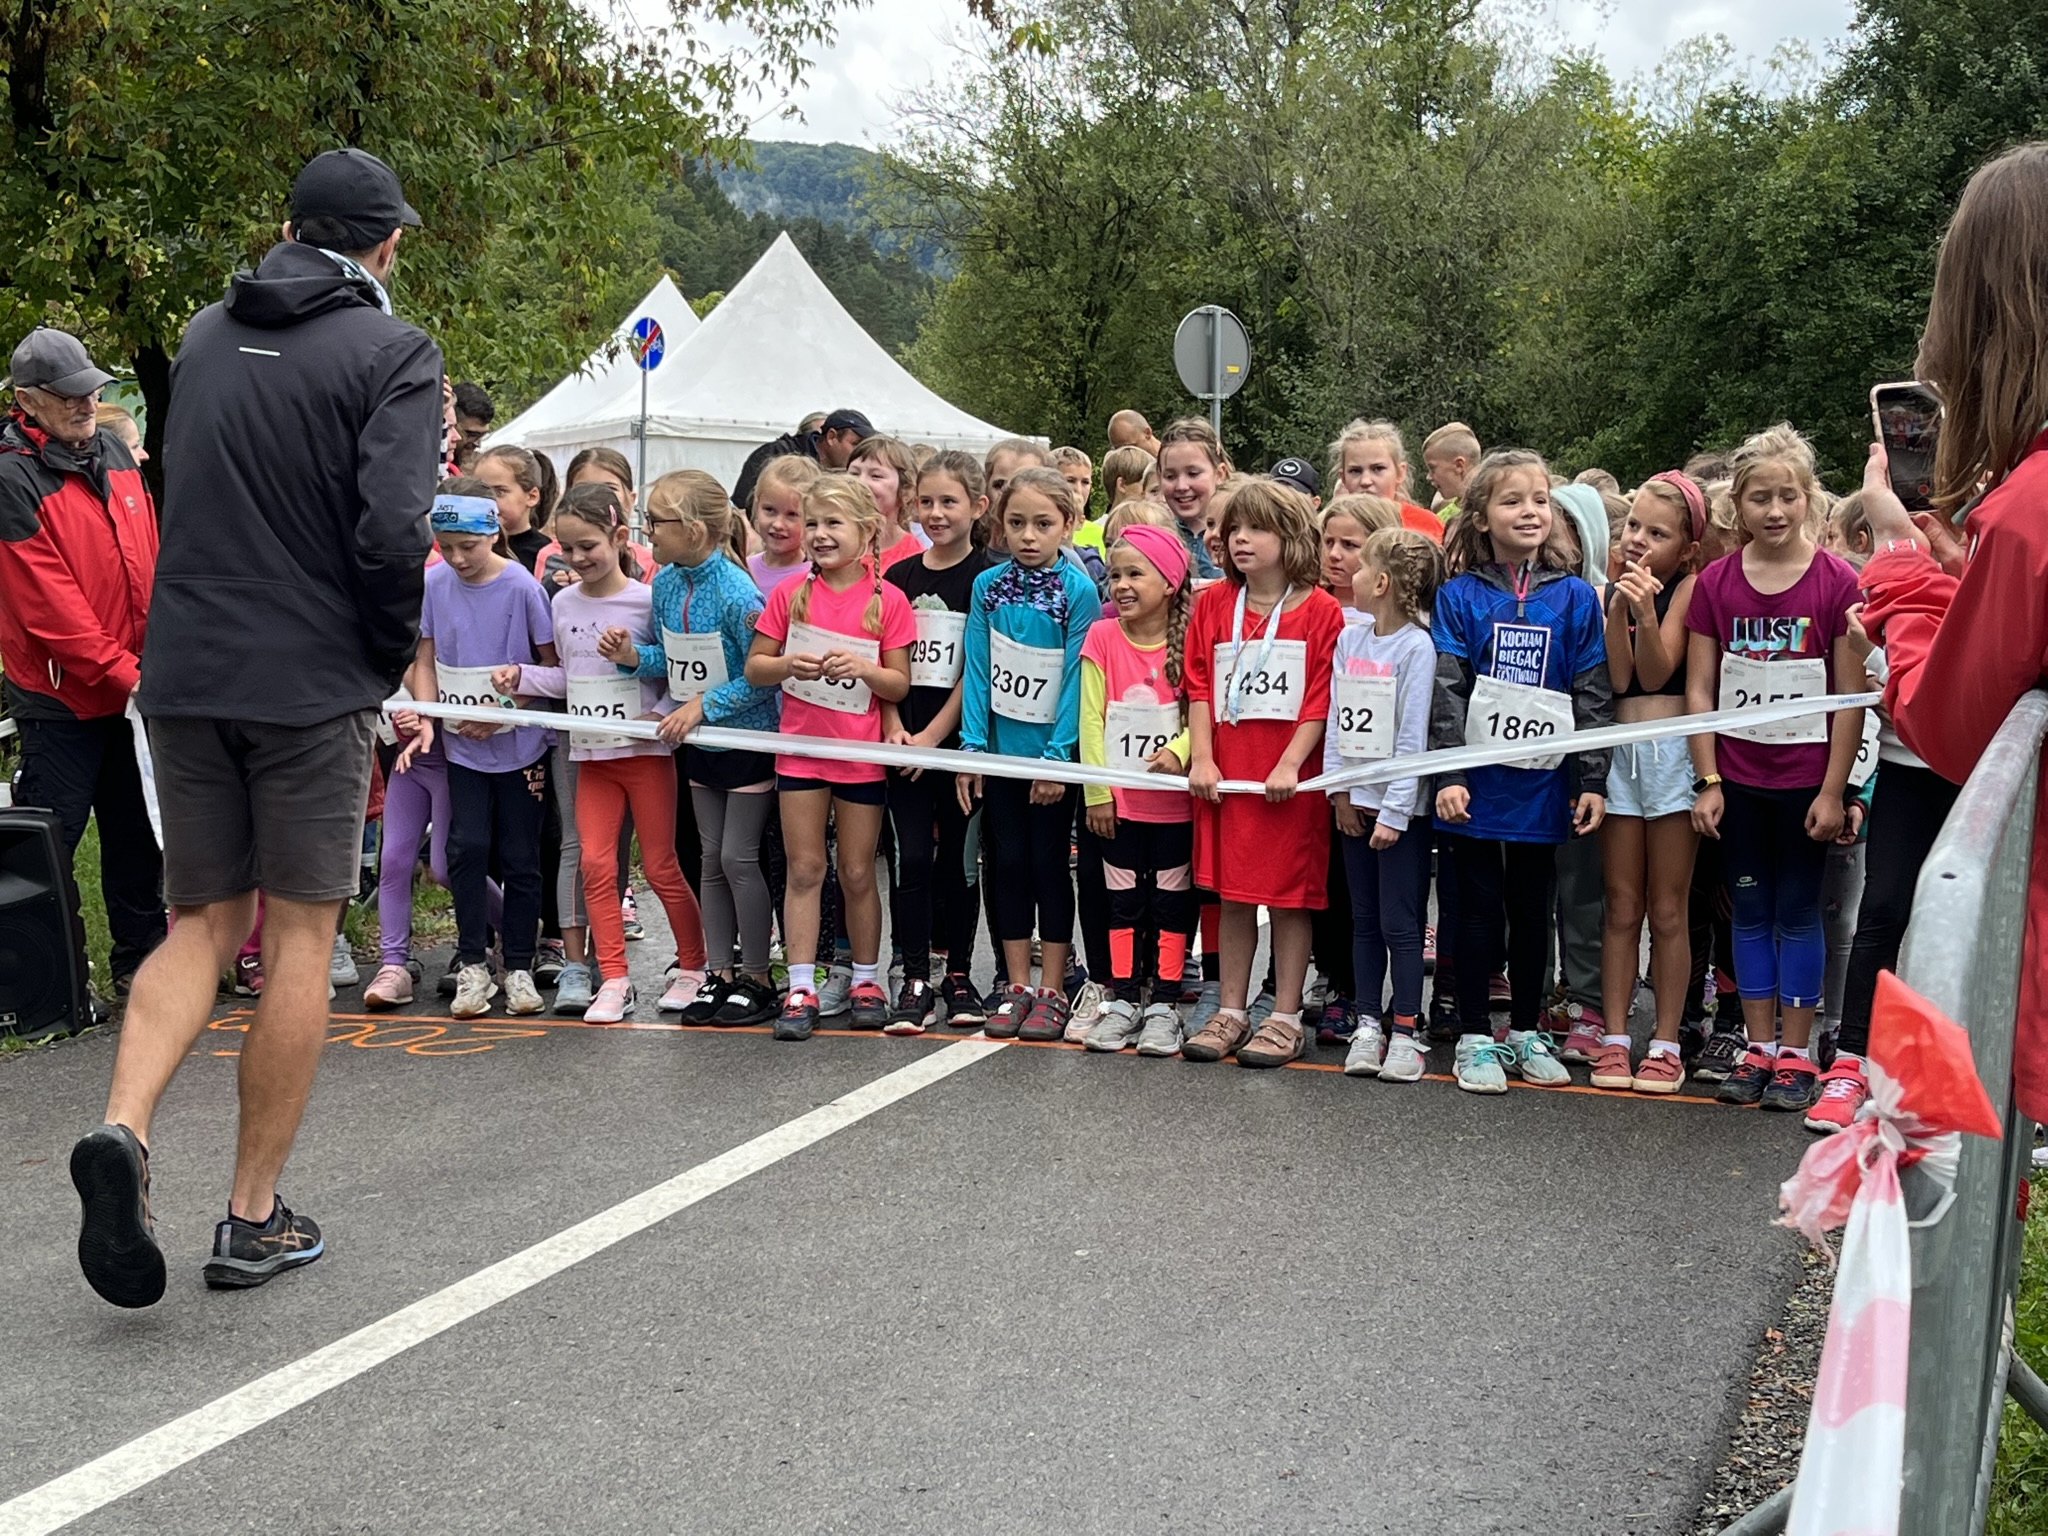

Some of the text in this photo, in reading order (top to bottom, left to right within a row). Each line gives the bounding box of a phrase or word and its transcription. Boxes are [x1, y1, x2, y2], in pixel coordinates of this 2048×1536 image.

[1500, 630, 1543, 648] KOCHAM
[1729, 617, 1811, 652] JUST
[911, 640, 955, 666] 2951
[1499, 648, 1542, 669] BIEGAĆ
[992, 663, 1048, 701] 2307
[1336, 706, 1374, 733] 32
[1120, 732, 1180, 758] 178
